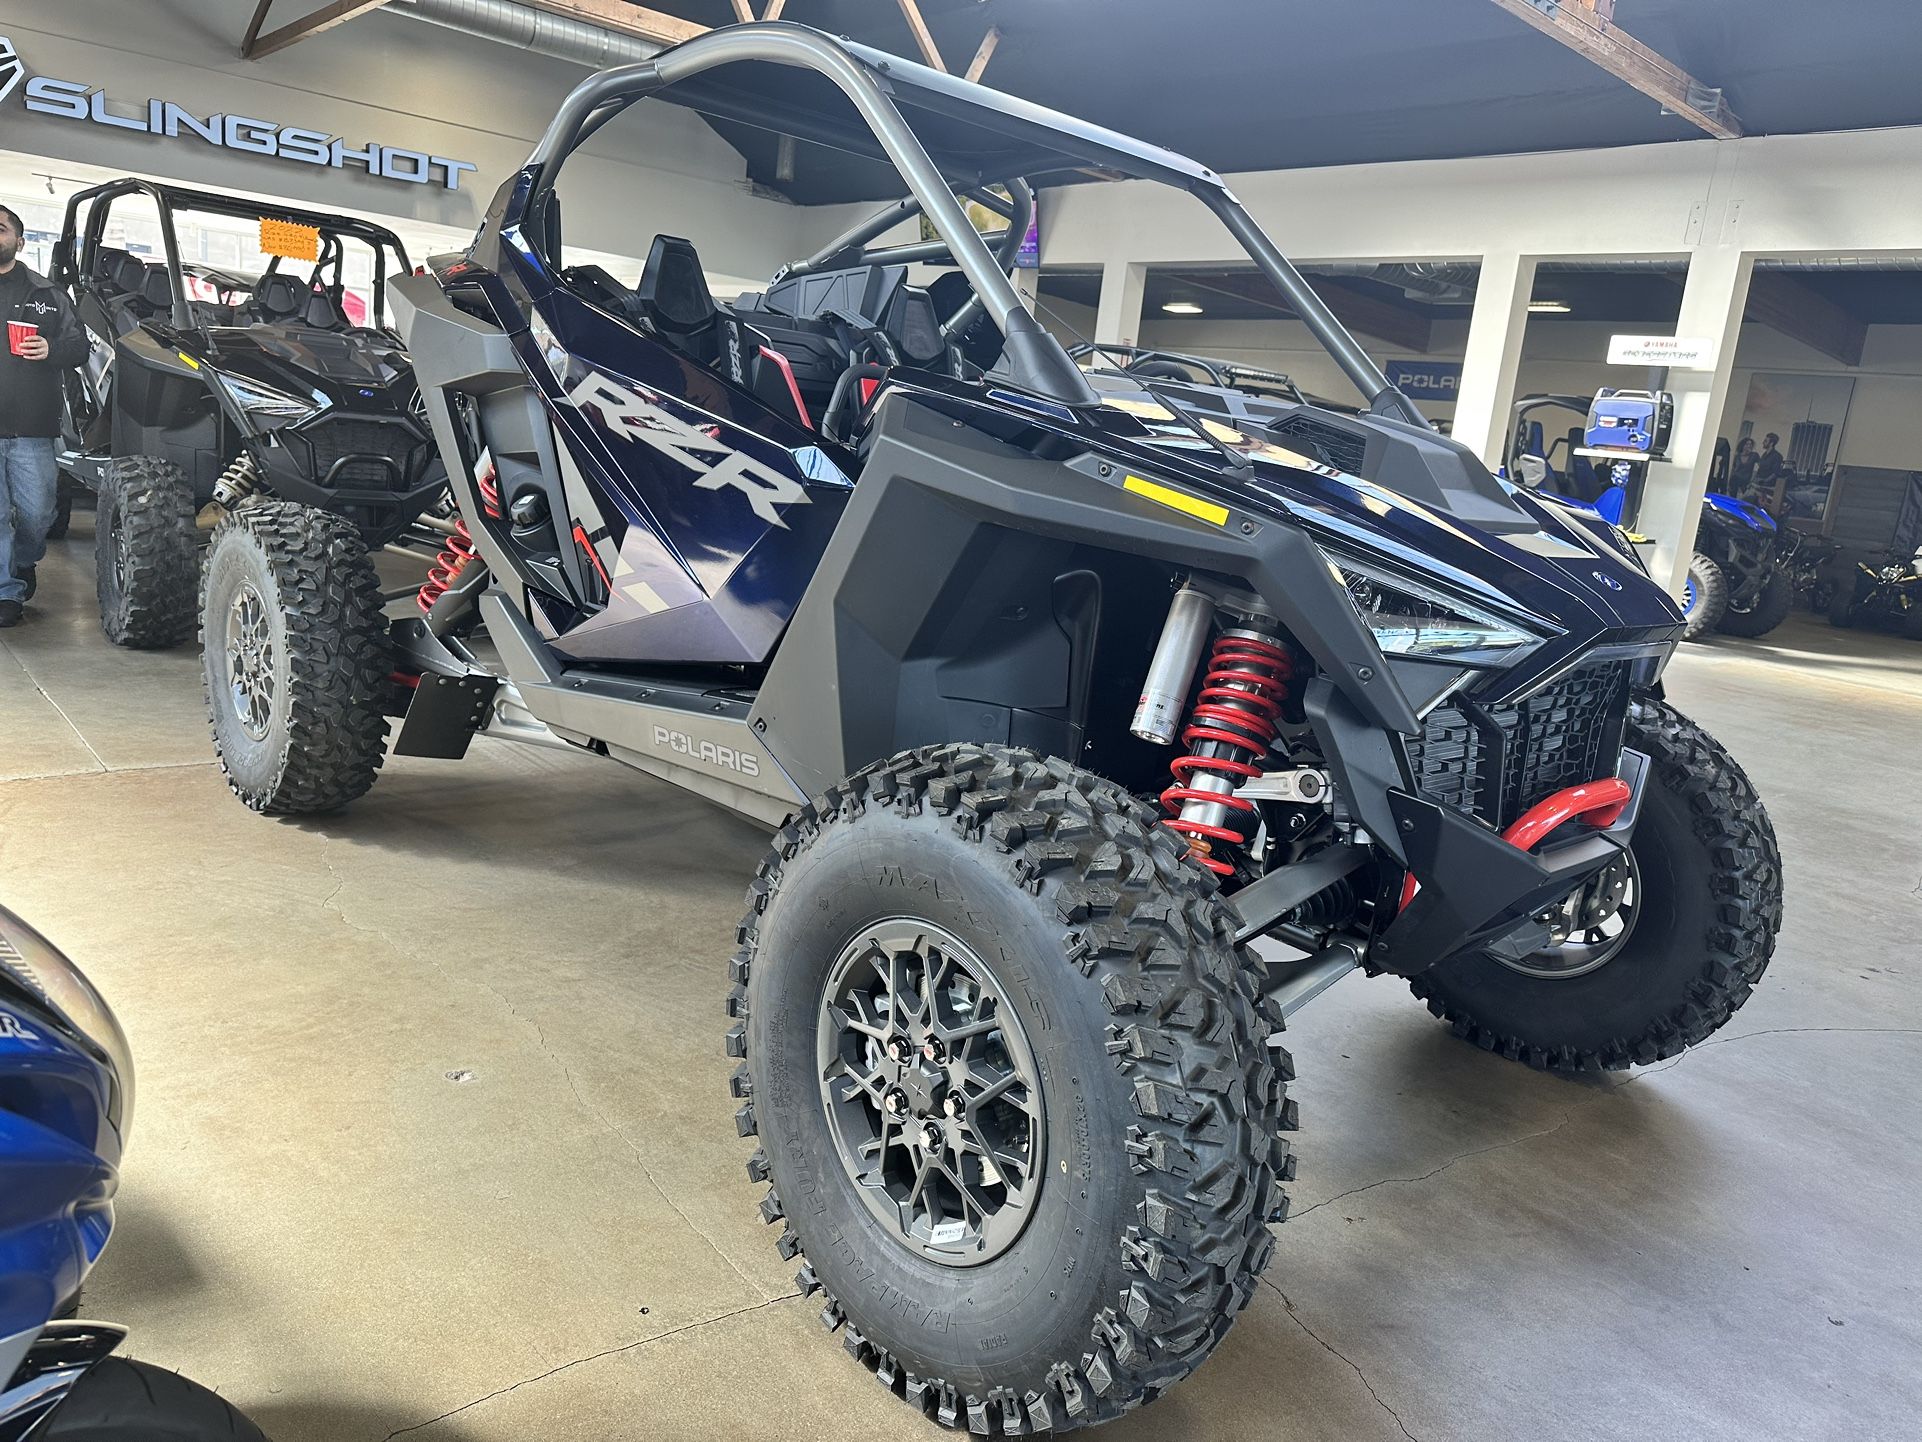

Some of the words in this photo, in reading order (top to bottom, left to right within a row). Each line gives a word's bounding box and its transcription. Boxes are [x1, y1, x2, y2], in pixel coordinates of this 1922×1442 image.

[24, 76, 479, 191] SLINGSHOT
[551, 370, 813, 531] RZR
[653, 724, 760, 777] POLARIS
[783, 1131, 828, 1217] FURY
[826, 1222, 951, 1335] RAMPAGE
